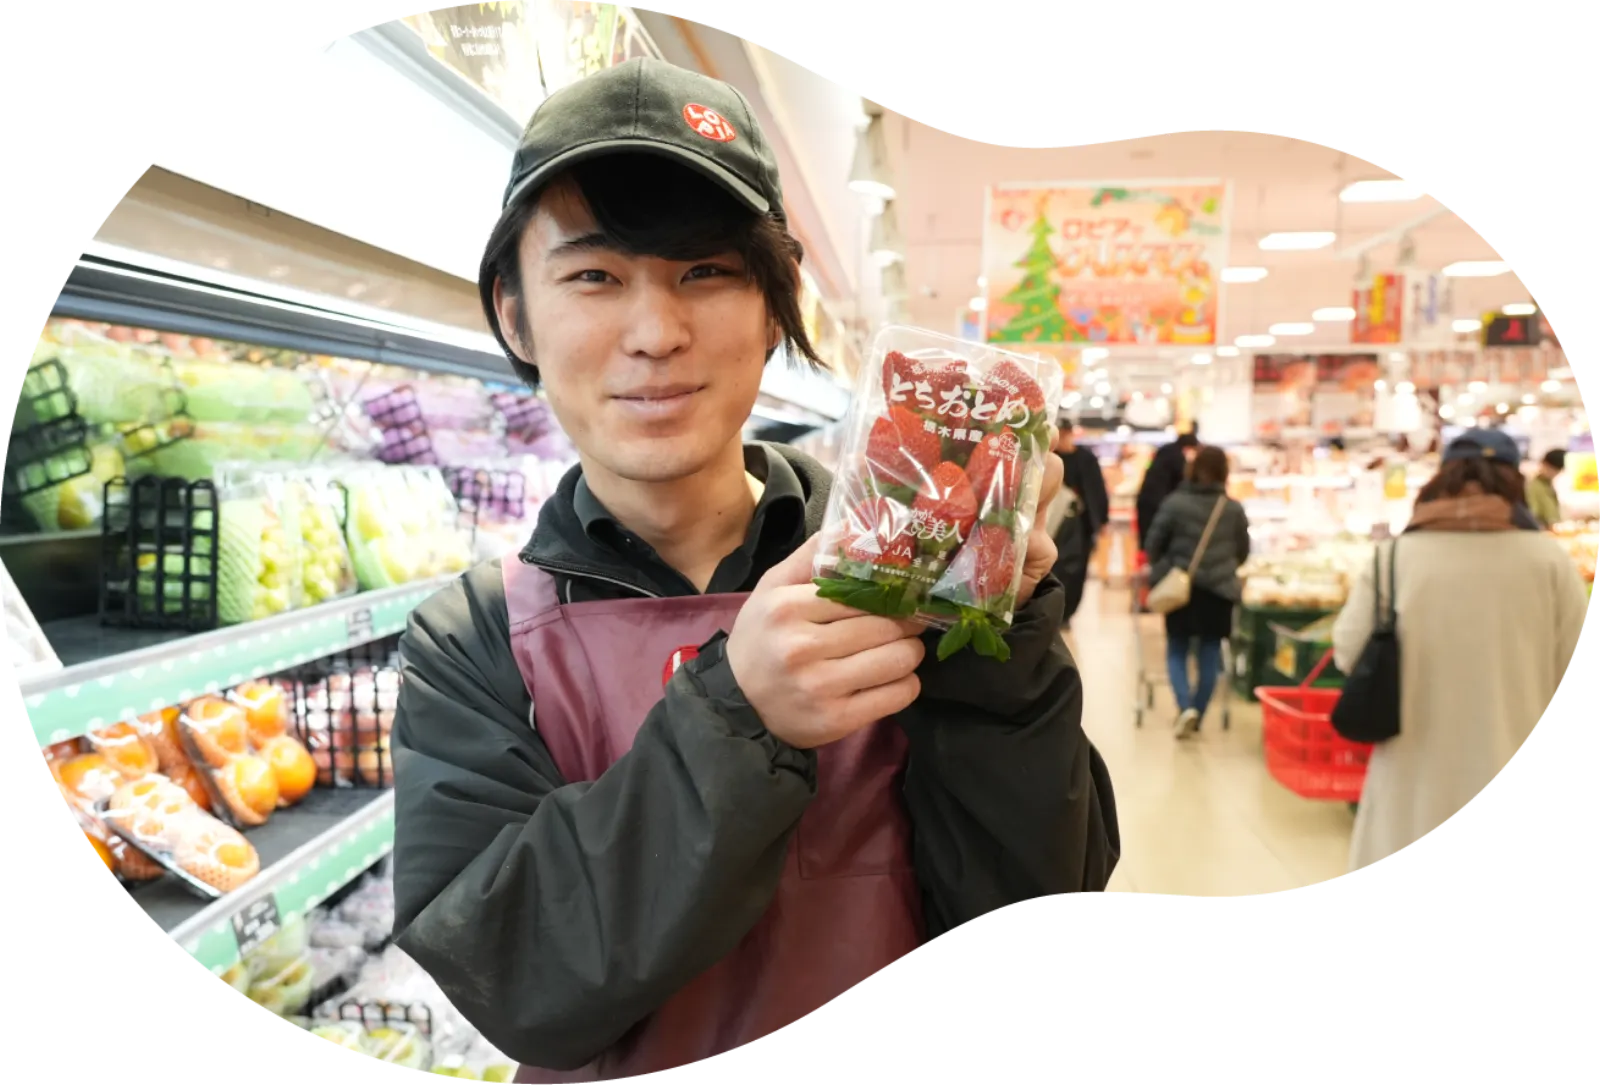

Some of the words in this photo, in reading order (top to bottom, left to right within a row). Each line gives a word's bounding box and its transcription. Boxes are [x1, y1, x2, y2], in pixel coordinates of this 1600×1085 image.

[889, 372, 1031, 429] とちおとめ
[923, 419, 984, 443] 栃木県産
[892, 544, 913, 559] JA
